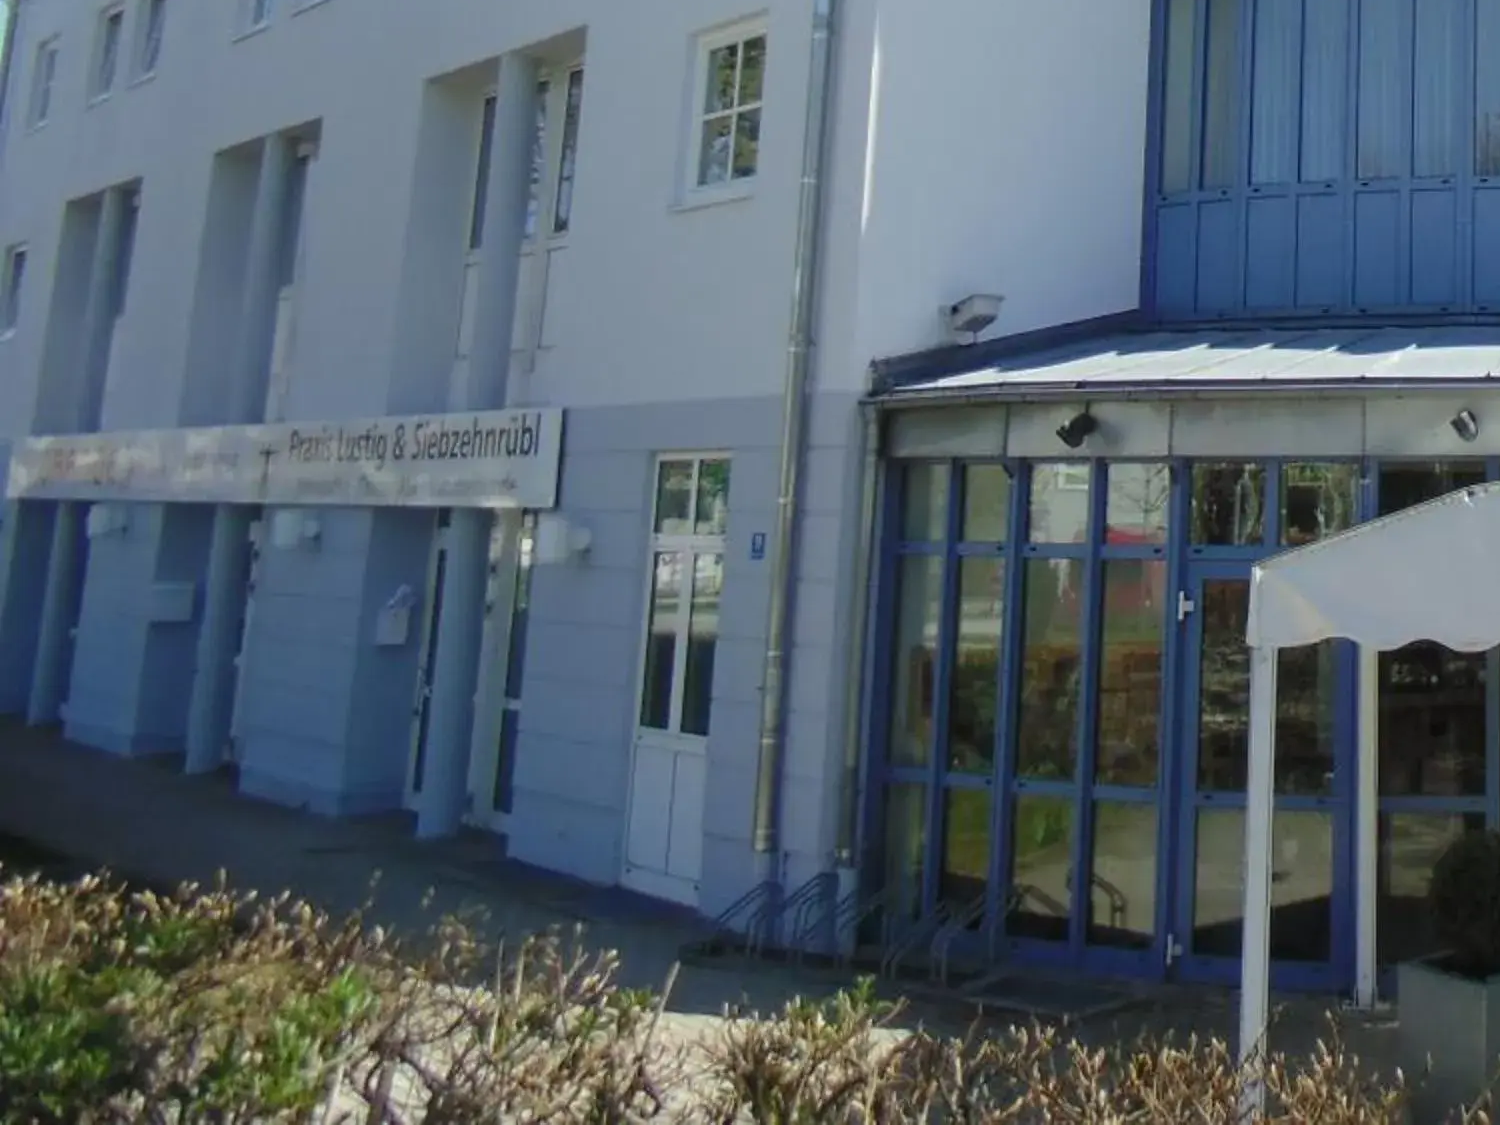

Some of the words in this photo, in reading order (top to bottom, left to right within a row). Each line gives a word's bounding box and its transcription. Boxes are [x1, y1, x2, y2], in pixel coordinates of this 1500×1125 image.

[336, 422, 388, 471] Lustig
[393, 424, 406, 460] &
[410, 411, 542, 460] Siebzehnrübl
